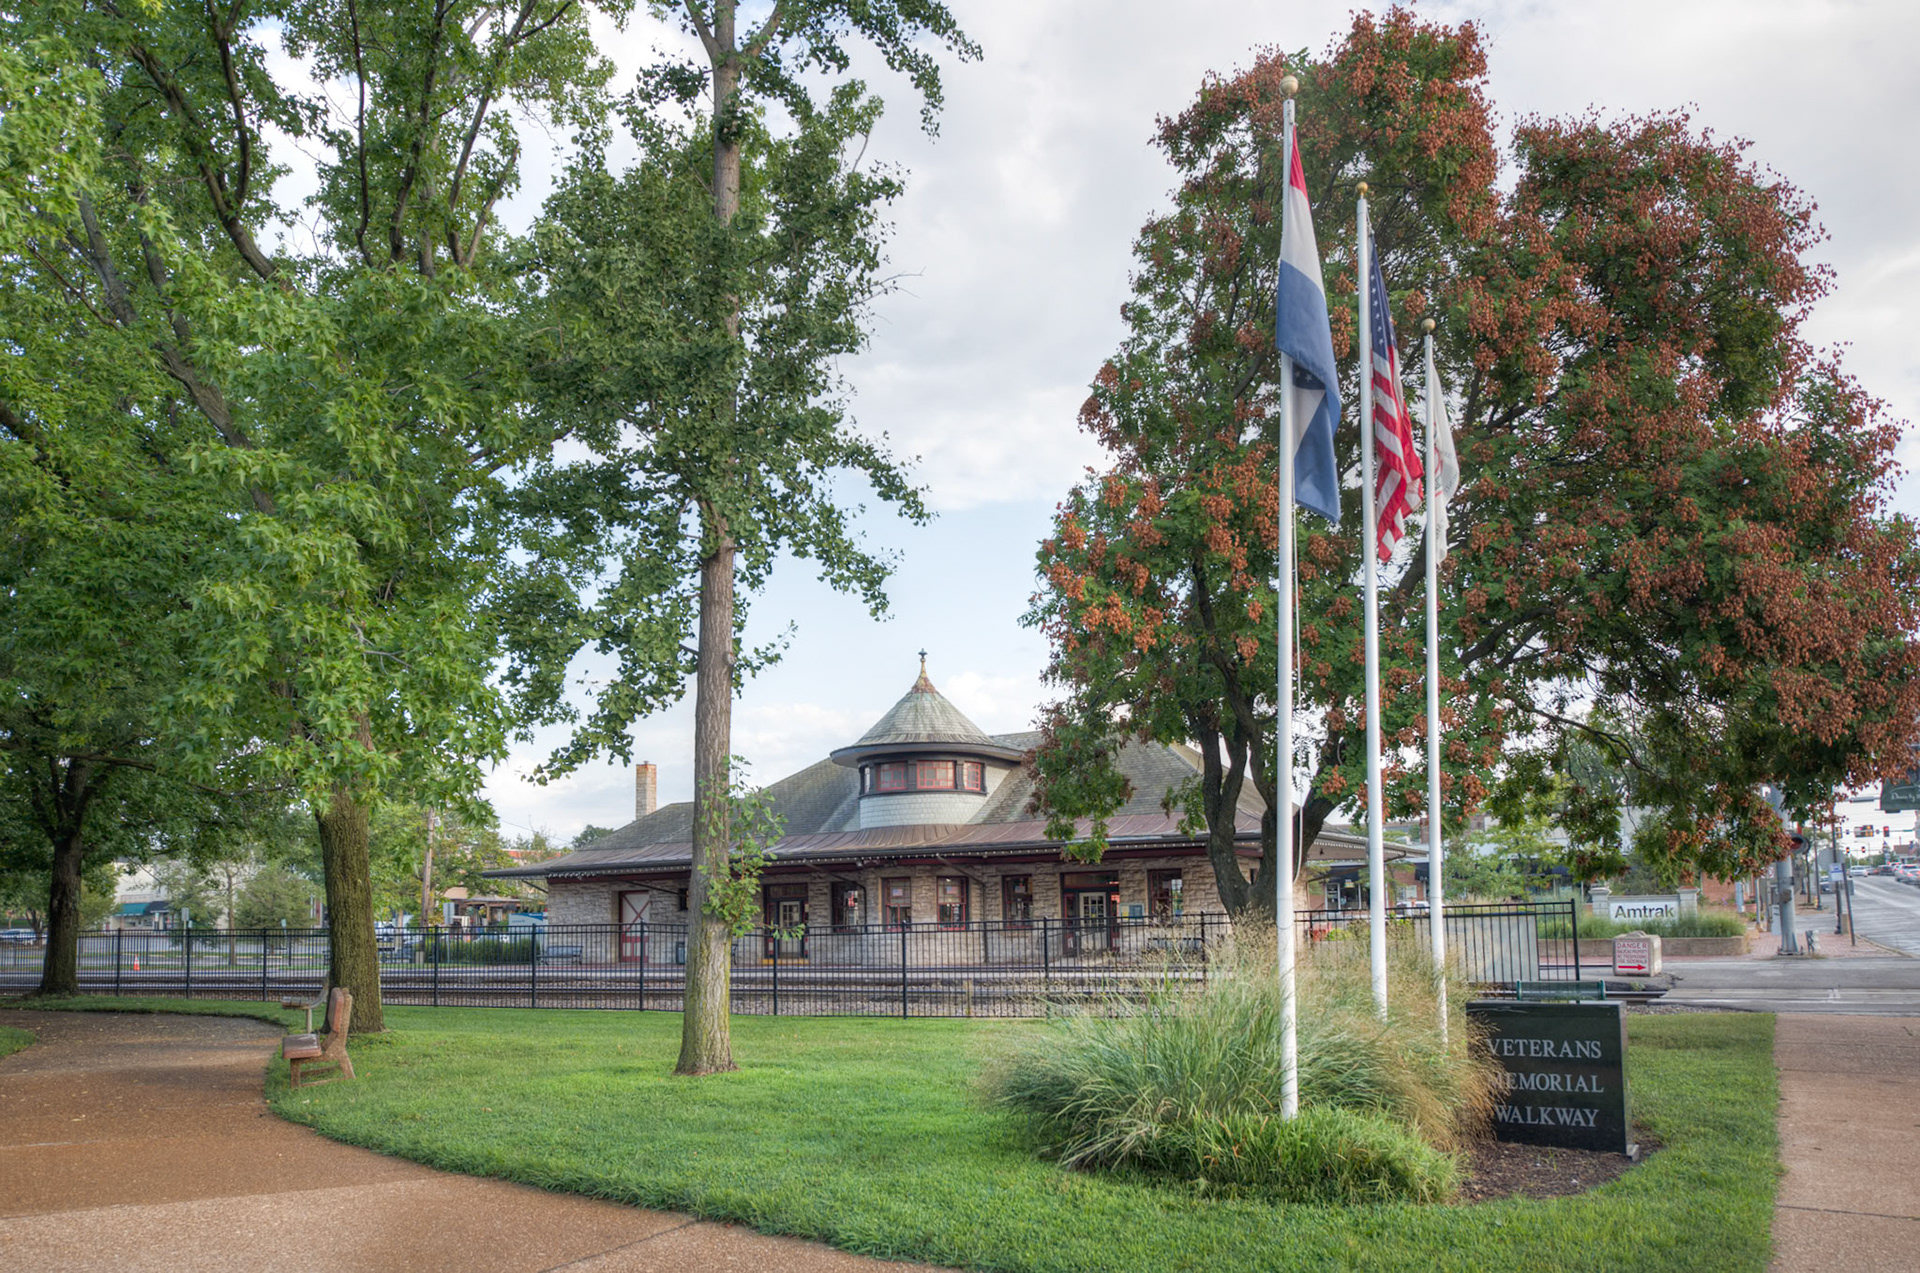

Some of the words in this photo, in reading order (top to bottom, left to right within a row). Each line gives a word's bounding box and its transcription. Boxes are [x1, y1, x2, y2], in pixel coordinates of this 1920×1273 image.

[1614, 904, 1675, 919] Amtrak
[1486, 1038, 1602, 1059] VETERANS
[1493, 1104, 1600, 1128] WALKWAY
